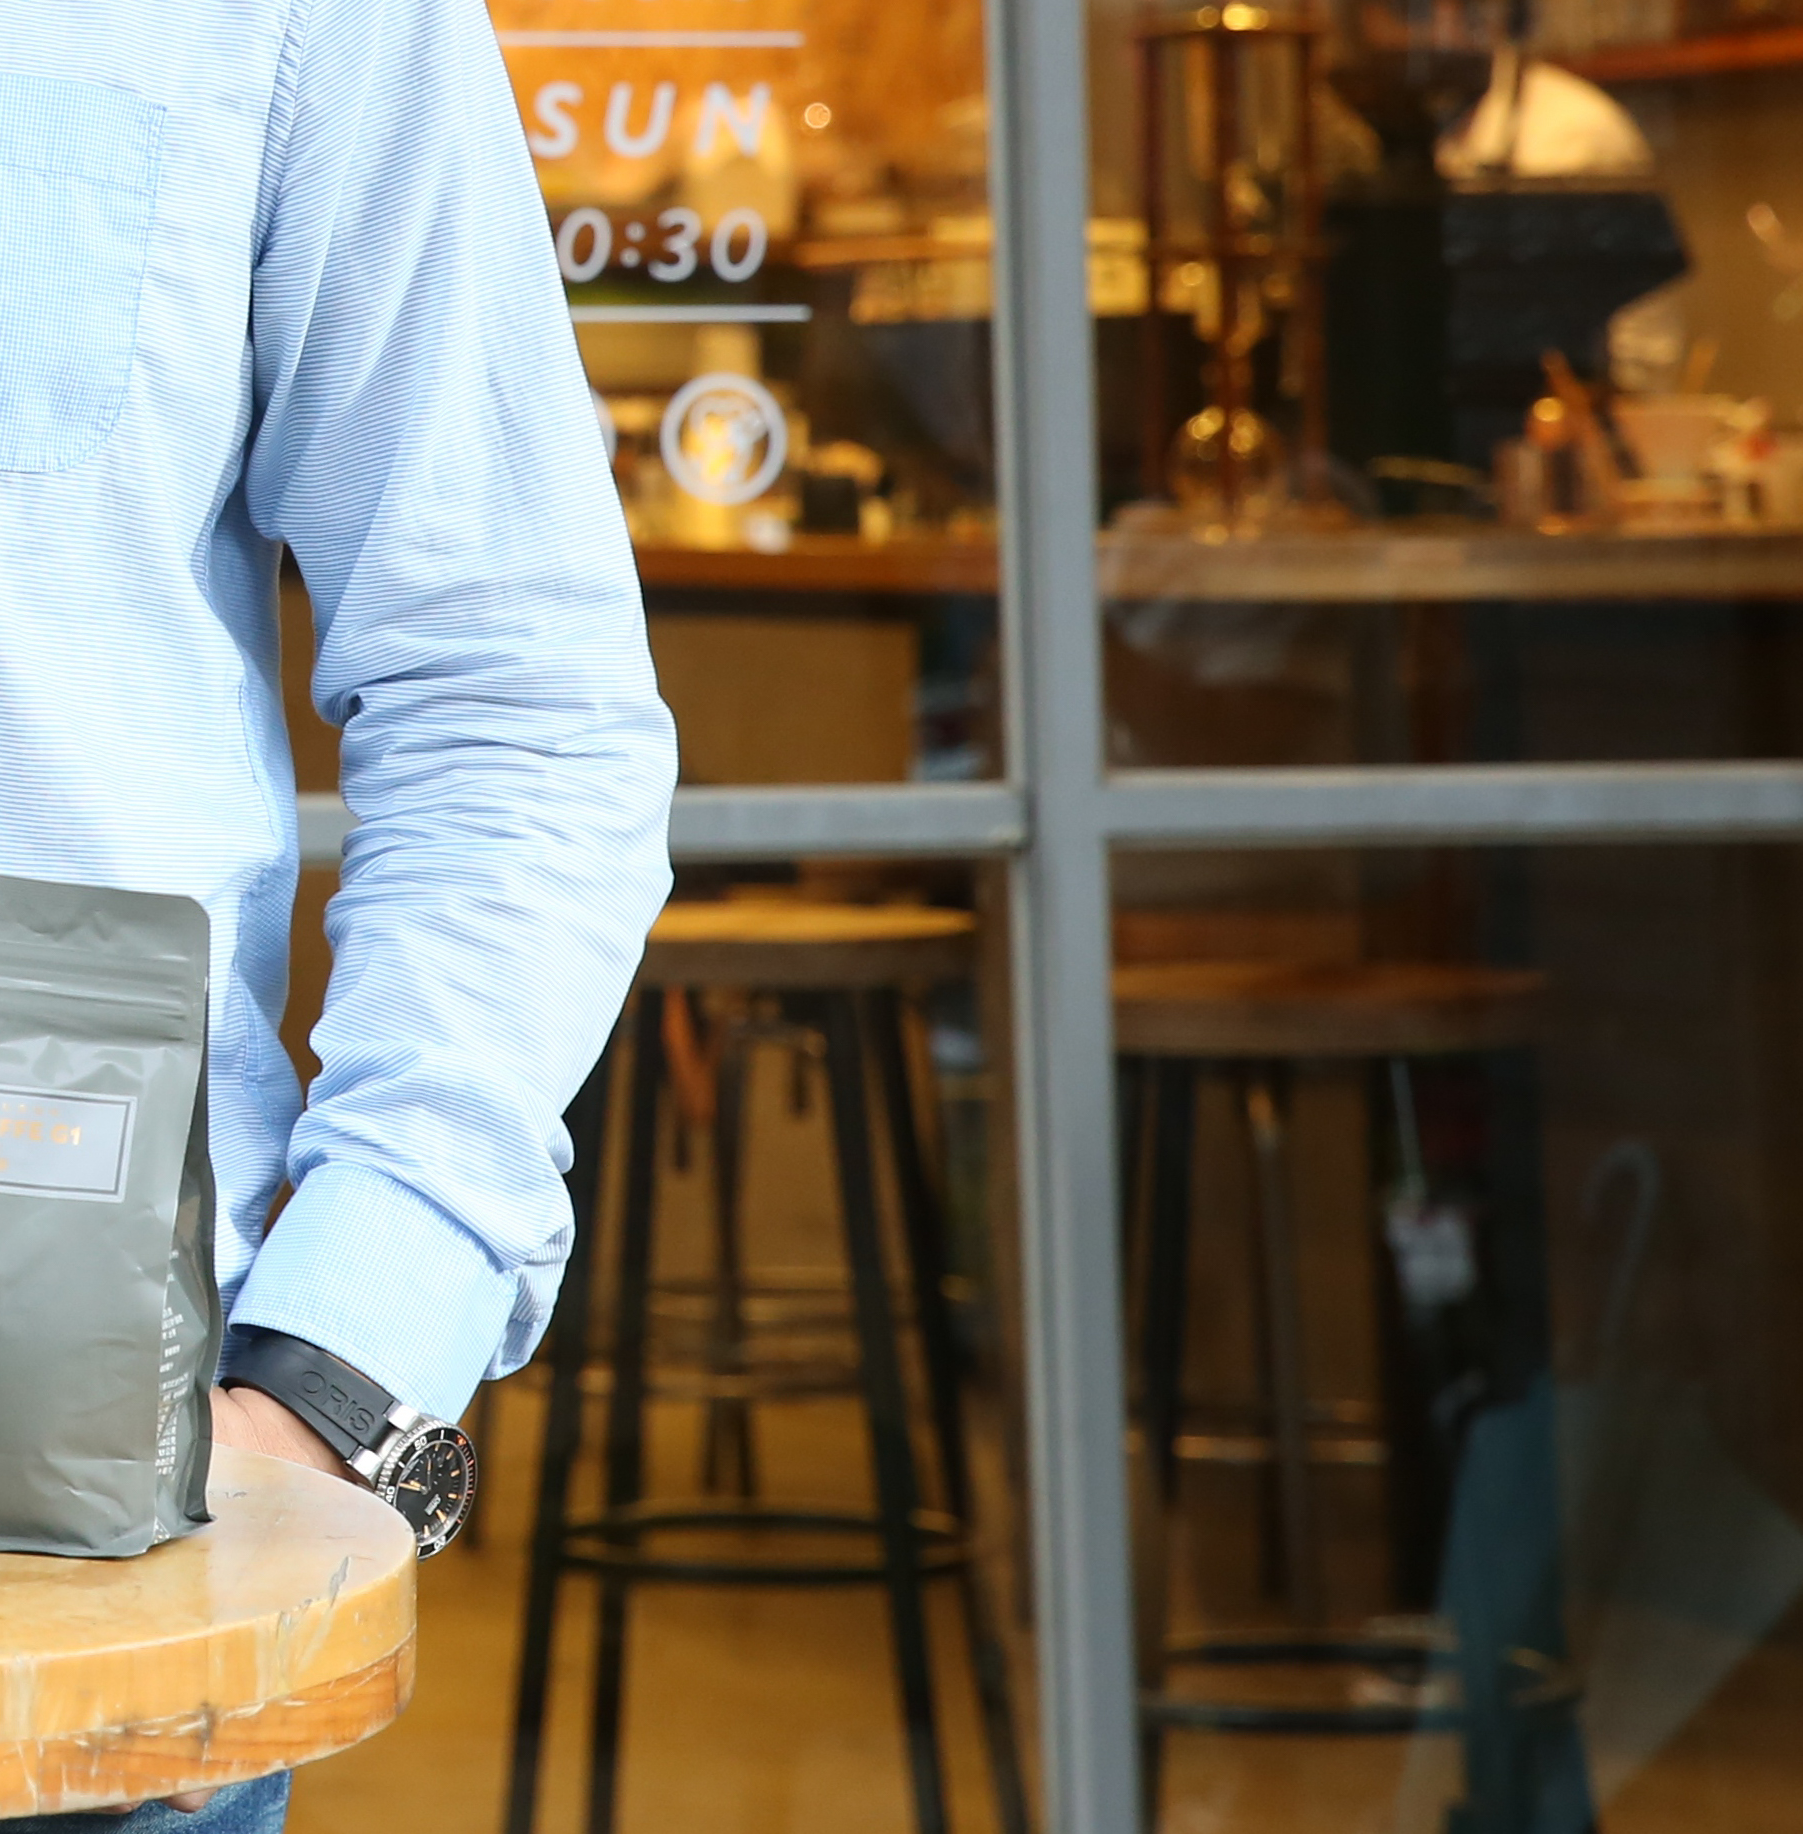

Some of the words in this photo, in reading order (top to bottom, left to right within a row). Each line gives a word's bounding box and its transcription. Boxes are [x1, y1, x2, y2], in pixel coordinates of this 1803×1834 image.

[526, 80, 772, 159] SUN
[50, 1124, 82, 1146] G1
[302, 1371, 375, 1434] ORIS
